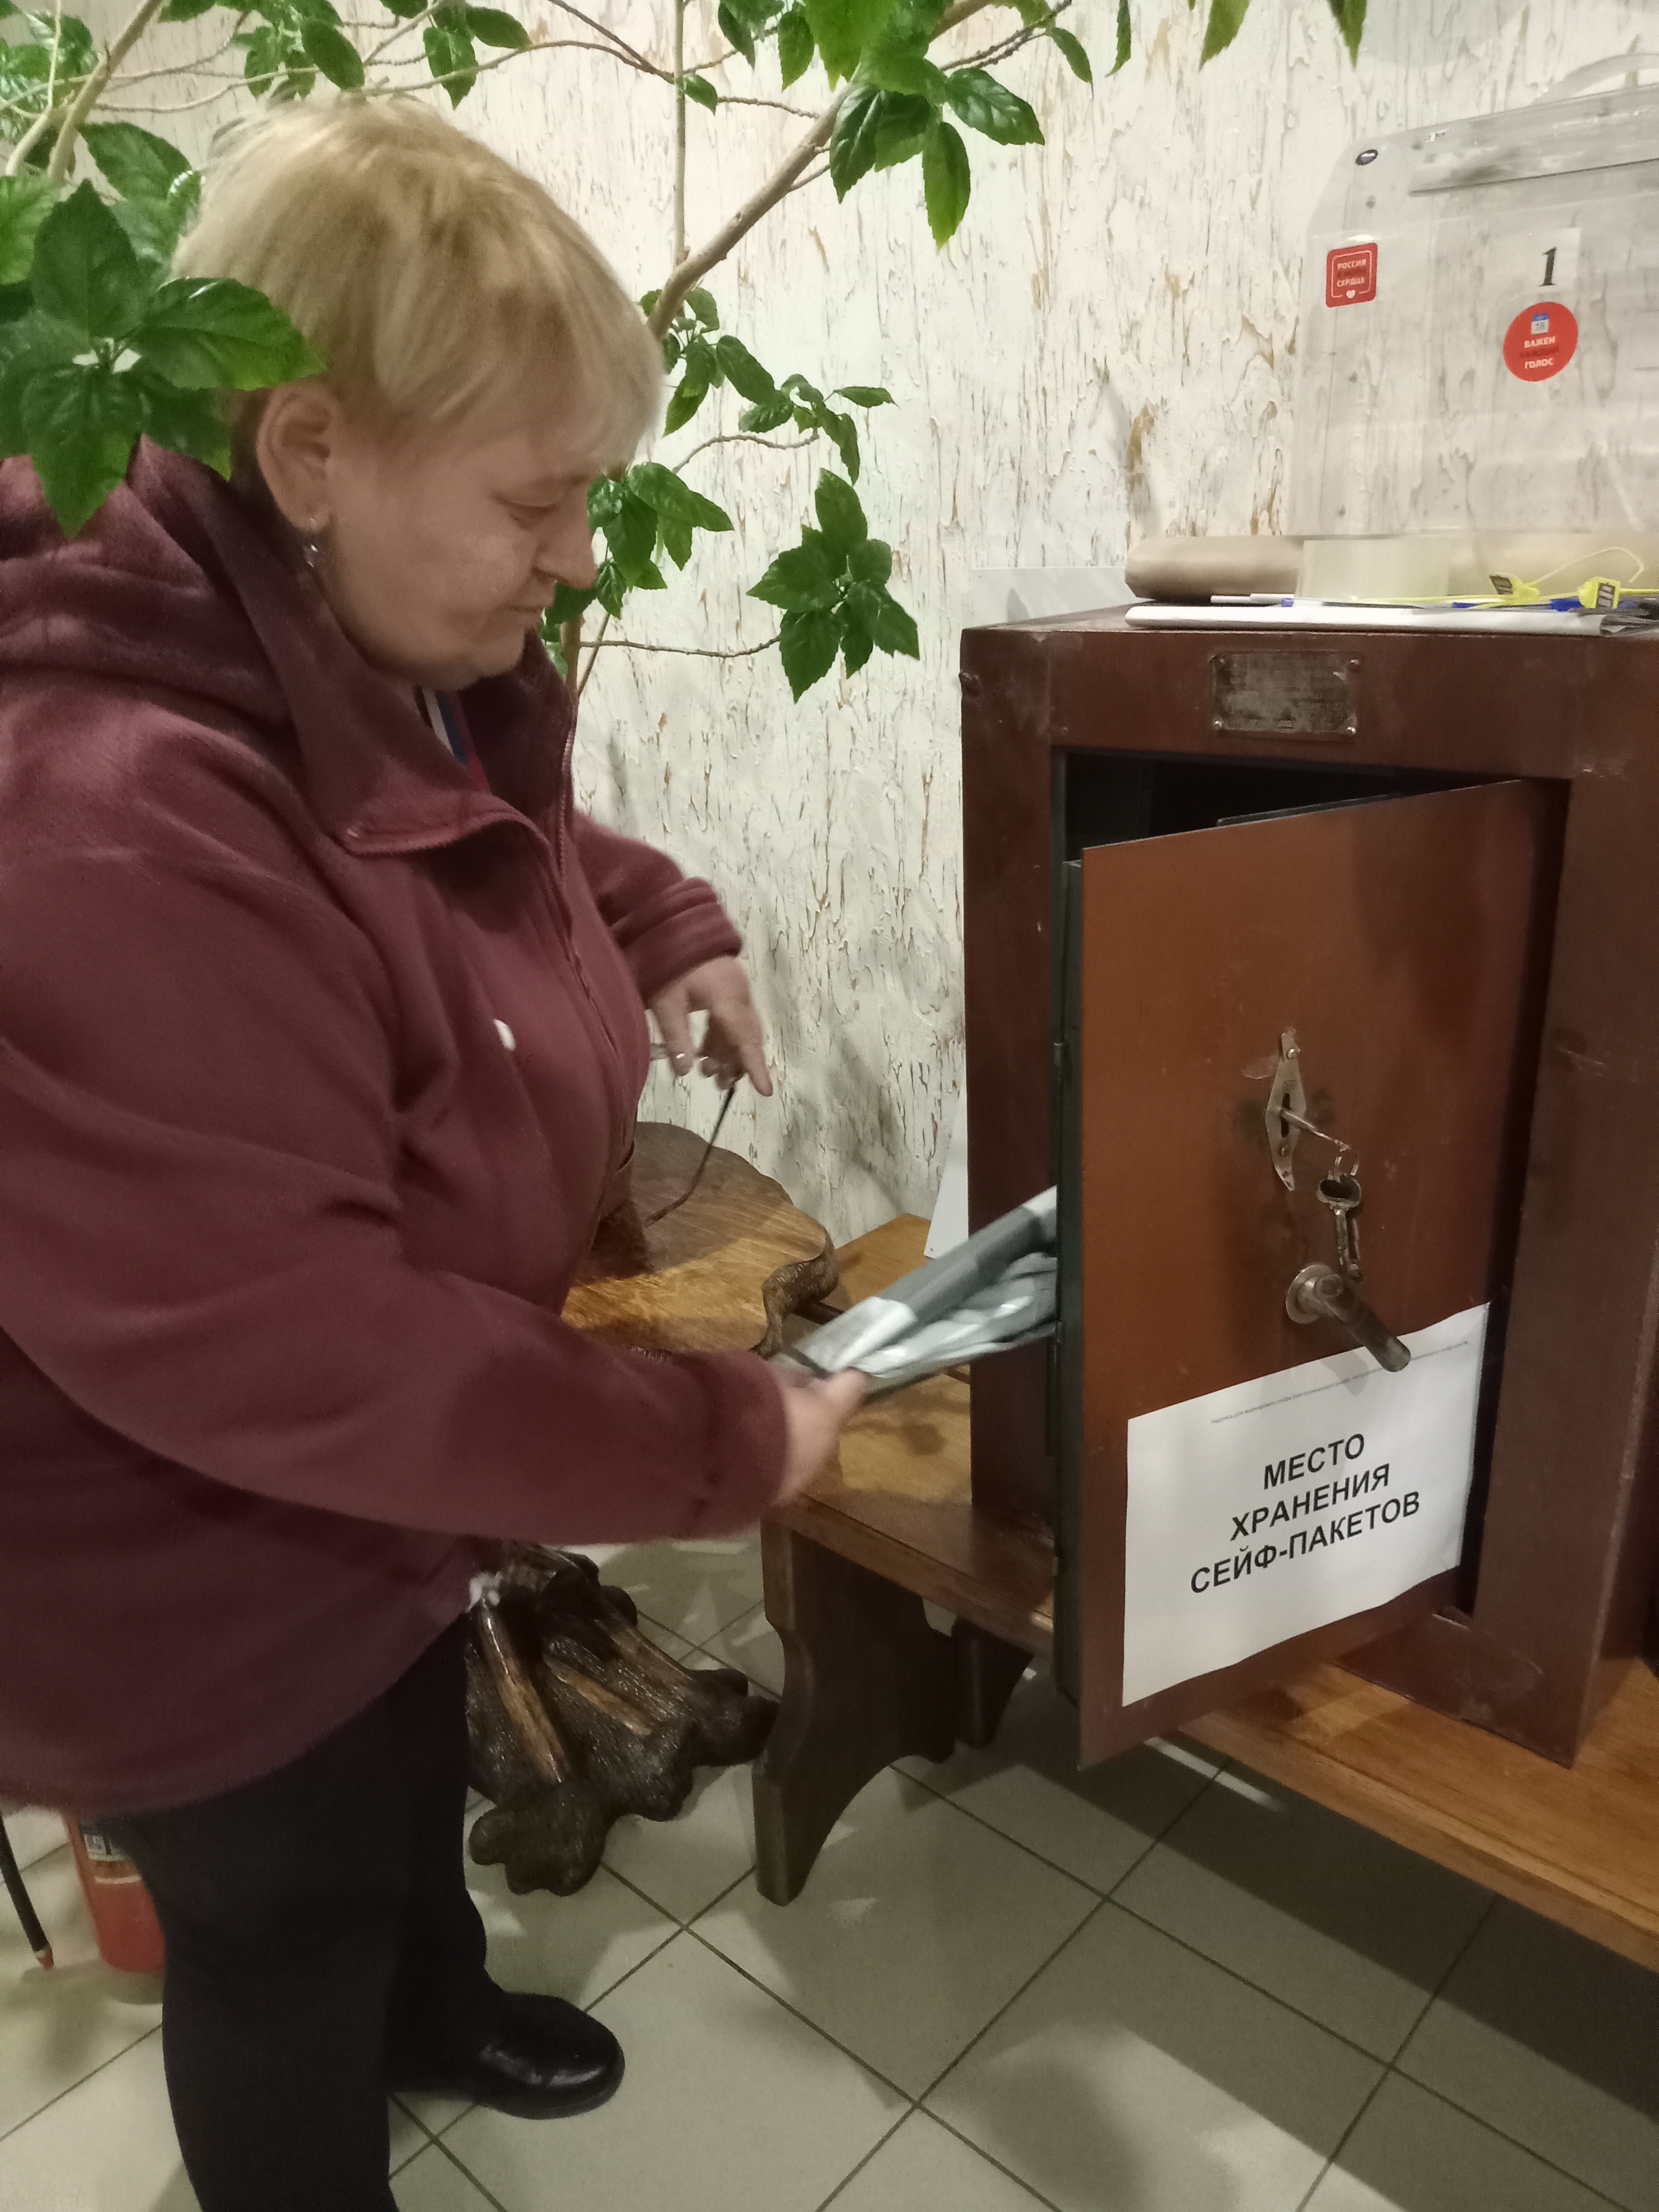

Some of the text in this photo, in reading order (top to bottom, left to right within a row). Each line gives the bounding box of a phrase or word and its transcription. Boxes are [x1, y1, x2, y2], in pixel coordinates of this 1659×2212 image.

[1337, 259, 1367, 270] РОССИЯ
[1539, 247, 1557, 287] 1
[1336, 276, 1365, 287] СЕРДЦЕ
[1524, 336, 1556, 348] ВАЖЕН
[1524, 357, 1554, 370] ГОЛОС
[1263, 1433, 1365, 1489] МЕСТО
[1230, 1463, 1390, 1540] ХРАНЕНИЯ
[1190, 1491, 1420, 1594] СЕЙФ-ПАКЕТОВ
